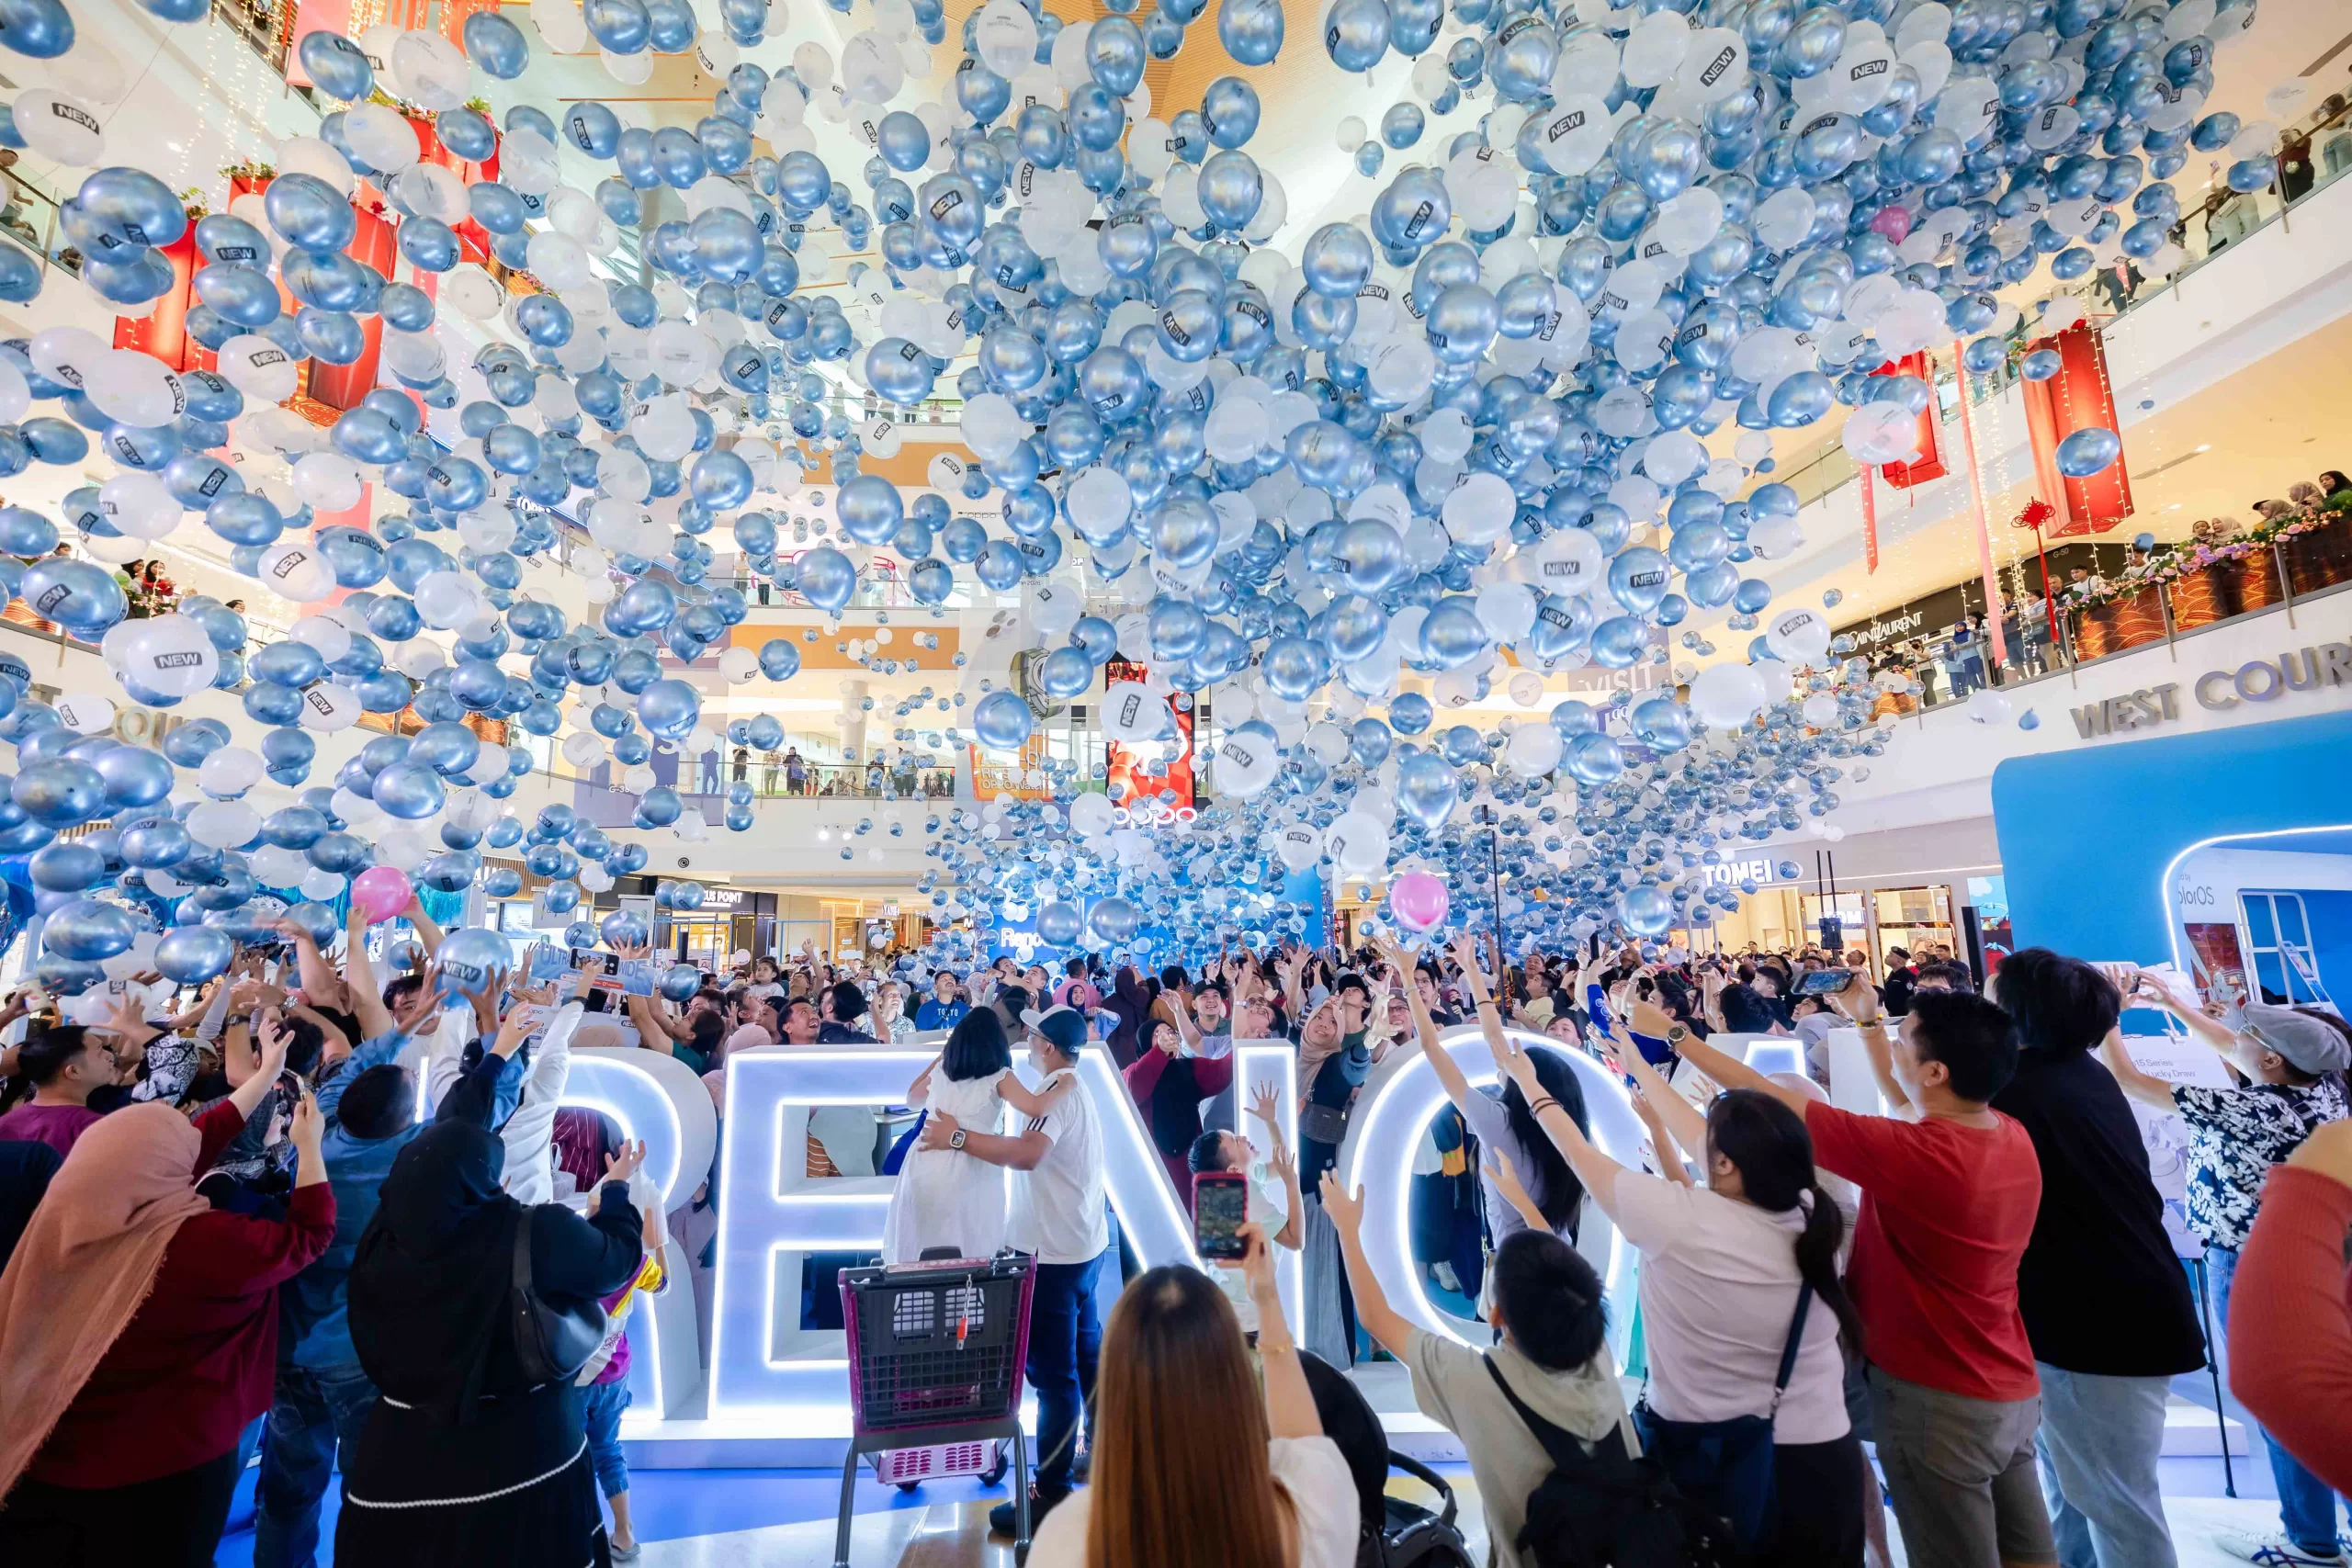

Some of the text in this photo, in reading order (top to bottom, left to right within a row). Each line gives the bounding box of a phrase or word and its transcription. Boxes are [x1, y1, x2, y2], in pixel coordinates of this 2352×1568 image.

[1503, 18, 1539, 39] NEW
[1328, 28, 1340, 58] EW
[1704, 49, 1732, 80] NEW
[1855, 62, 1885, 77] NEW
[1985, 100, 1997, 114] NE
[60, 108, 96, 131] NEW
[1553, 113, 1581, 137] NEW
[1804, 118, 1832, 135] NEW
[2041, 109, 2056, 130] NEW
[575, 118, 591, 150] NEW
[864, 121, 876, 141] NEW
[1984, 141, 2001, 153] NEW
[1021, 165, 1035, 195] NEW
[890, 203, 908, 220] NEW
[931, 191, 962, 219] NEW
[2083, 204, 2100, 221] NEW
[1408, 205, 1430, 237] NEW
[220, 248, 254, 259] NEW
[944, 245, 961, 266] NEW
[1647, 243, 1662, 256] NE
[1360, 287, 1386, 299] NEW
[1608, 293, 1625, 307] NEW
[771, 306, 784, 322] NEW
[1405, 296, 1419, 315] NEW
[1590, 299, 1605, 318] NEW
[947, 310, 961, 330] NE
[1240, 303, 1267, 327] NEW
[1165, 314, 1188, 344] NEW
[1544, 311, 1561, 341] NEW
[1682, 325, 1703, 344] NEW
[1799, 334, 1809, 344] NE
[253, 352, 283, 366] NEW
[902, 345, 918, 358] NE
[61, 368, 83, 387] NE
[738, 360, 761, 378] NEW
[198, 372, 220, 391] NEW
[1321, 380, 1336, 399] NEW
[170, 379, 184, 412] NEW
[874, 423, 890, 440] NEW
[119, 439, 141, 464] NEW
[1492, 444, 1513, 467] NEW
[943, 458, 960, 474] NEW
[203, 471, 225, 493] NEW
[1526, 516, 1540, 533] NEW
[355, 537, 381, 553] NEW
[1023, 546, 1043, 556] NEW
[277, 553, 302, 575] NEW
[1331, 558, 1349, 571] EW
[1545, 563, 1578, 573] NEW
[1159, 573, 1184, 590] NEW
[1633, 574, 1662, 585] NEW
[1543, 610, 1568, 626] NEW
[1782, 616, 1808, 633] NEW
[160, 654, 198, 666] NEW
[3, 665, 28, 679] NEW
[311, 694, 330, 712] NEW
[1125, 696, 1137, 723] NEW
[2070, 682, 2177, 739] WEST
[62, 706, 76, 725] NEW
[1225, 746, 1250, 764] NEW
[1702, 859, 1773, 887] TOMEI
[717, 891, 742, 904] POINT
[443, 964, 476, 979] NEW
[110, 980, 125, 993] NE
[937, 1008, 958, 1017] TOYO
